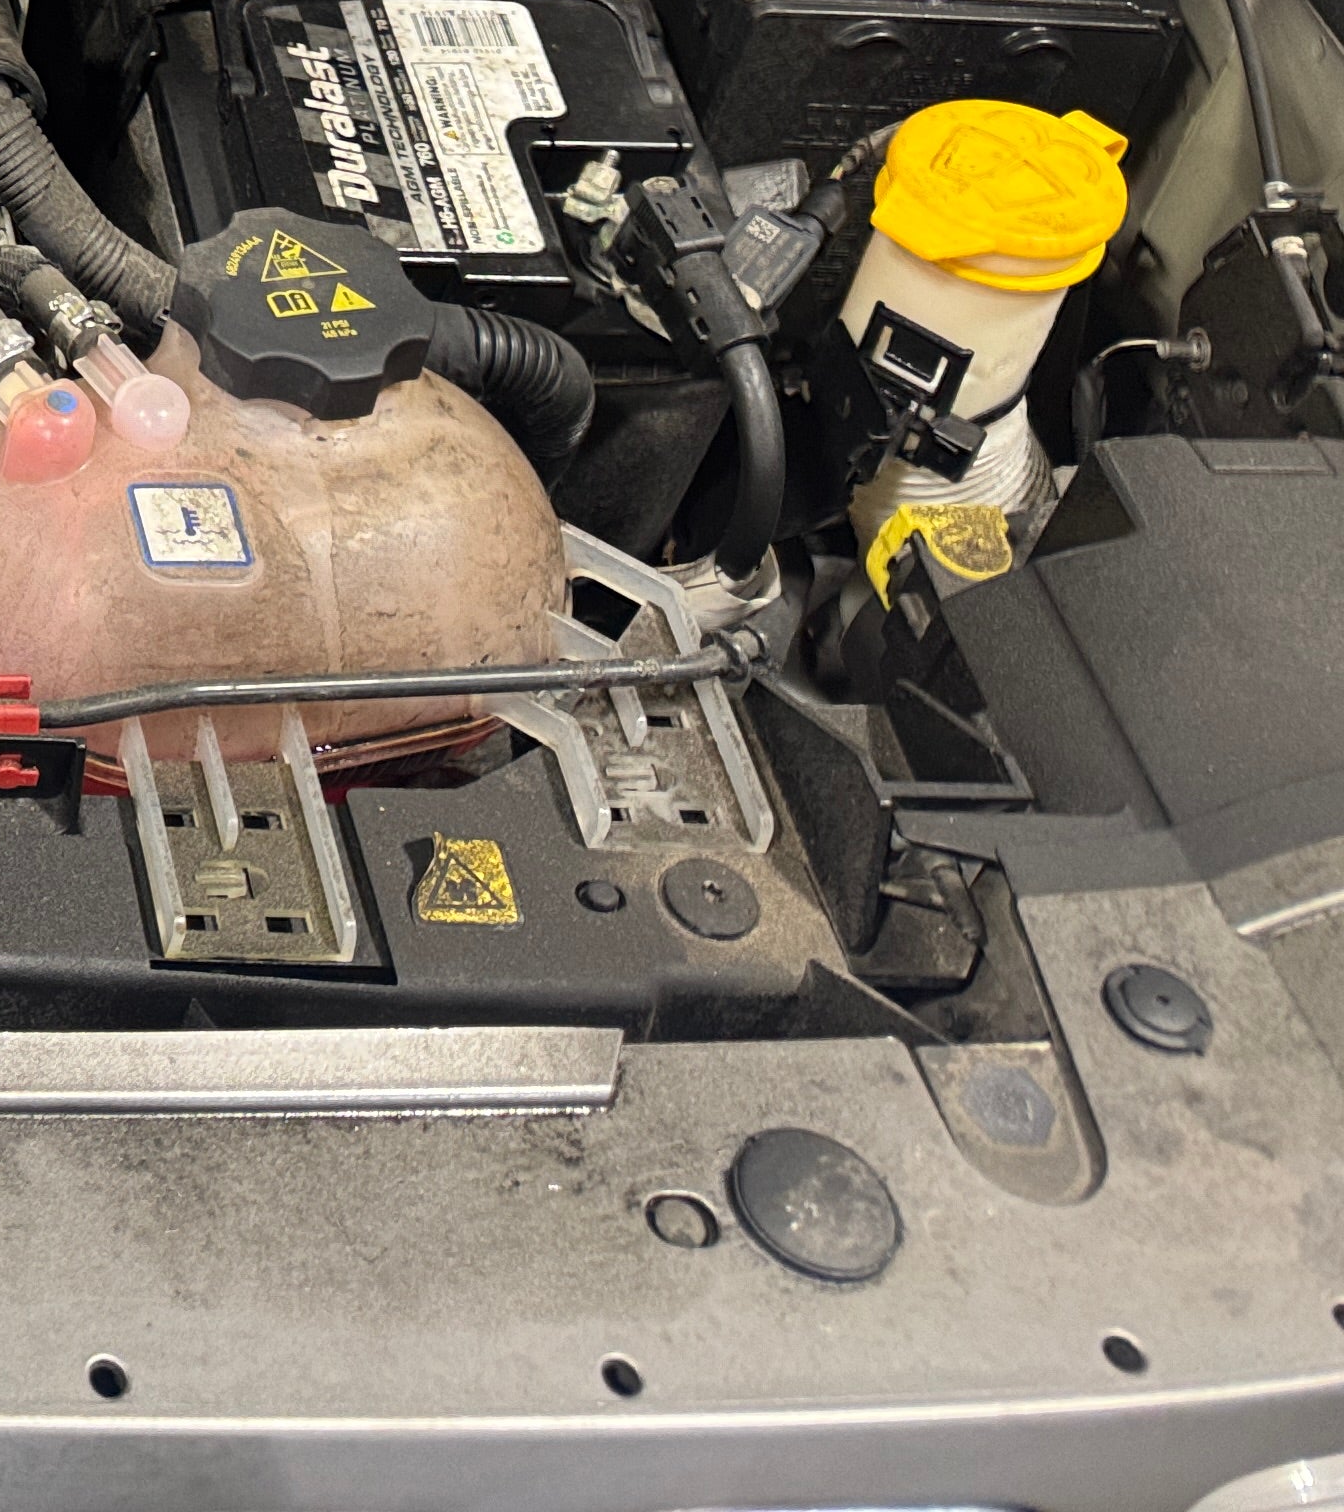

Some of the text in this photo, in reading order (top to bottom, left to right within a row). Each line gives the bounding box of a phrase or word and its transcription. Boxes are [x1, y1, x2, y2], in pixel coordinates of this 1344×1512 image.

[286, 41, 381, 208] Duralast
[332, 48, 380, 145] PLATINUM
[361, 53, 426, 206] AGM TECHNOLOGY
[413, 142, 437, 167] 760
[426, 176, 460, 229] H6-AGM
